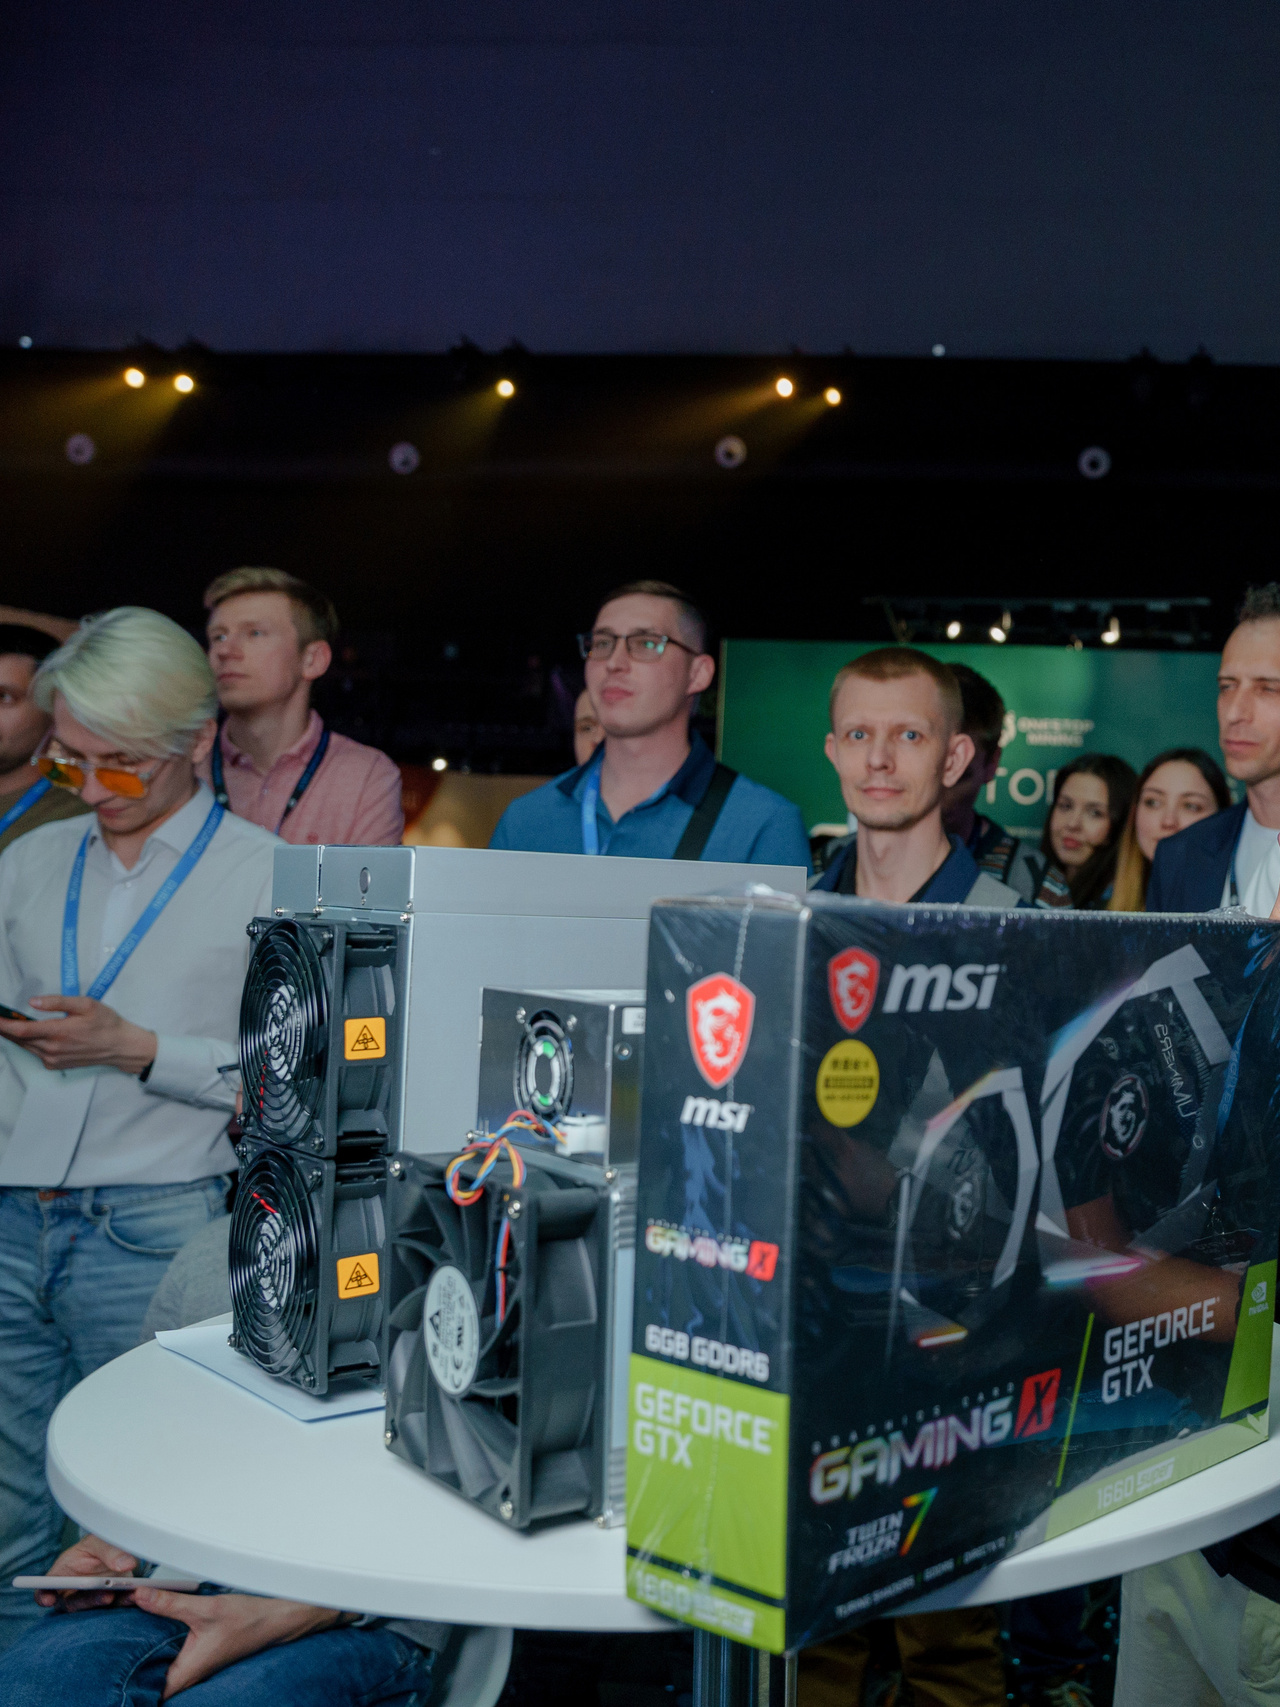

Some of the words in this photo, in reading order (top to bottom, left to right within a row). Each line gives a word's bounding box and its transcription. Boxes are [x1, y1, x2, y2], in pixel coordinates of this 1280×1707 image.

[882, 963, 1000, 1014] msi
[680, 1095, 751, 1133] msi
[645, 1225, 751, 1273] GAMING
[645, 1324, 690, 1361] 6GB
[691, 1336, 770, 1383] GDDR6
[1104, 1297, 1216, 1365] GEFORCE
[1102, 1355, 1155, 1405] GTX
[634, 1419, 694, 1470] GTX
[635, 1382, 774, 1456] GEFORCE
[810, 1396, 1014, 1505] GAMING
[1097, 1475, 1135, 1510] 1660
[847, 1510, 904, 1547] TWIN
[902, 1486, 939, 1556] 7
